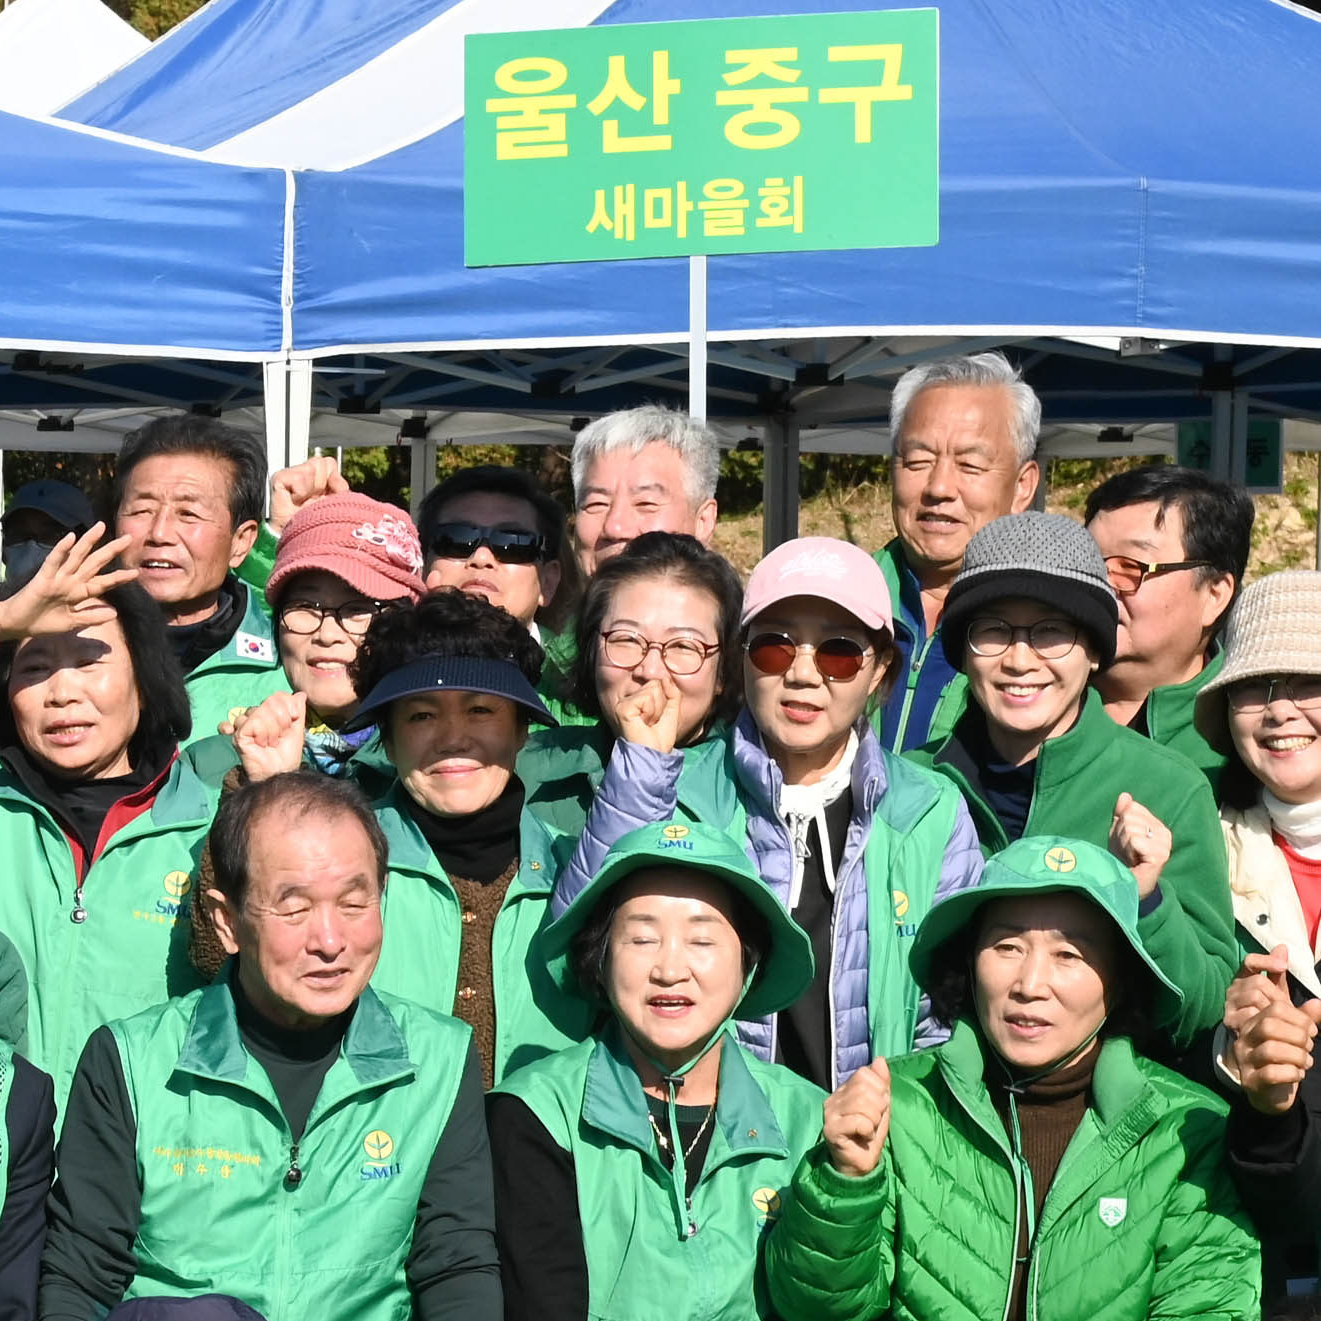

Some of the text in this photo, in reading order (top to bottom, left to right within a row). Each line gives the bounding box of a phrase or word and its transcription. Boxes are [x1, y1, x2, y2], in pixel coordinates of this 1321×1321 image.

[486, 43, 913, 161] 울산 중구
[585, 175, 806, 242] 새마을회
[656, 839, 695, 850] SMU
[360, 1162, 401, 1182] SMU
